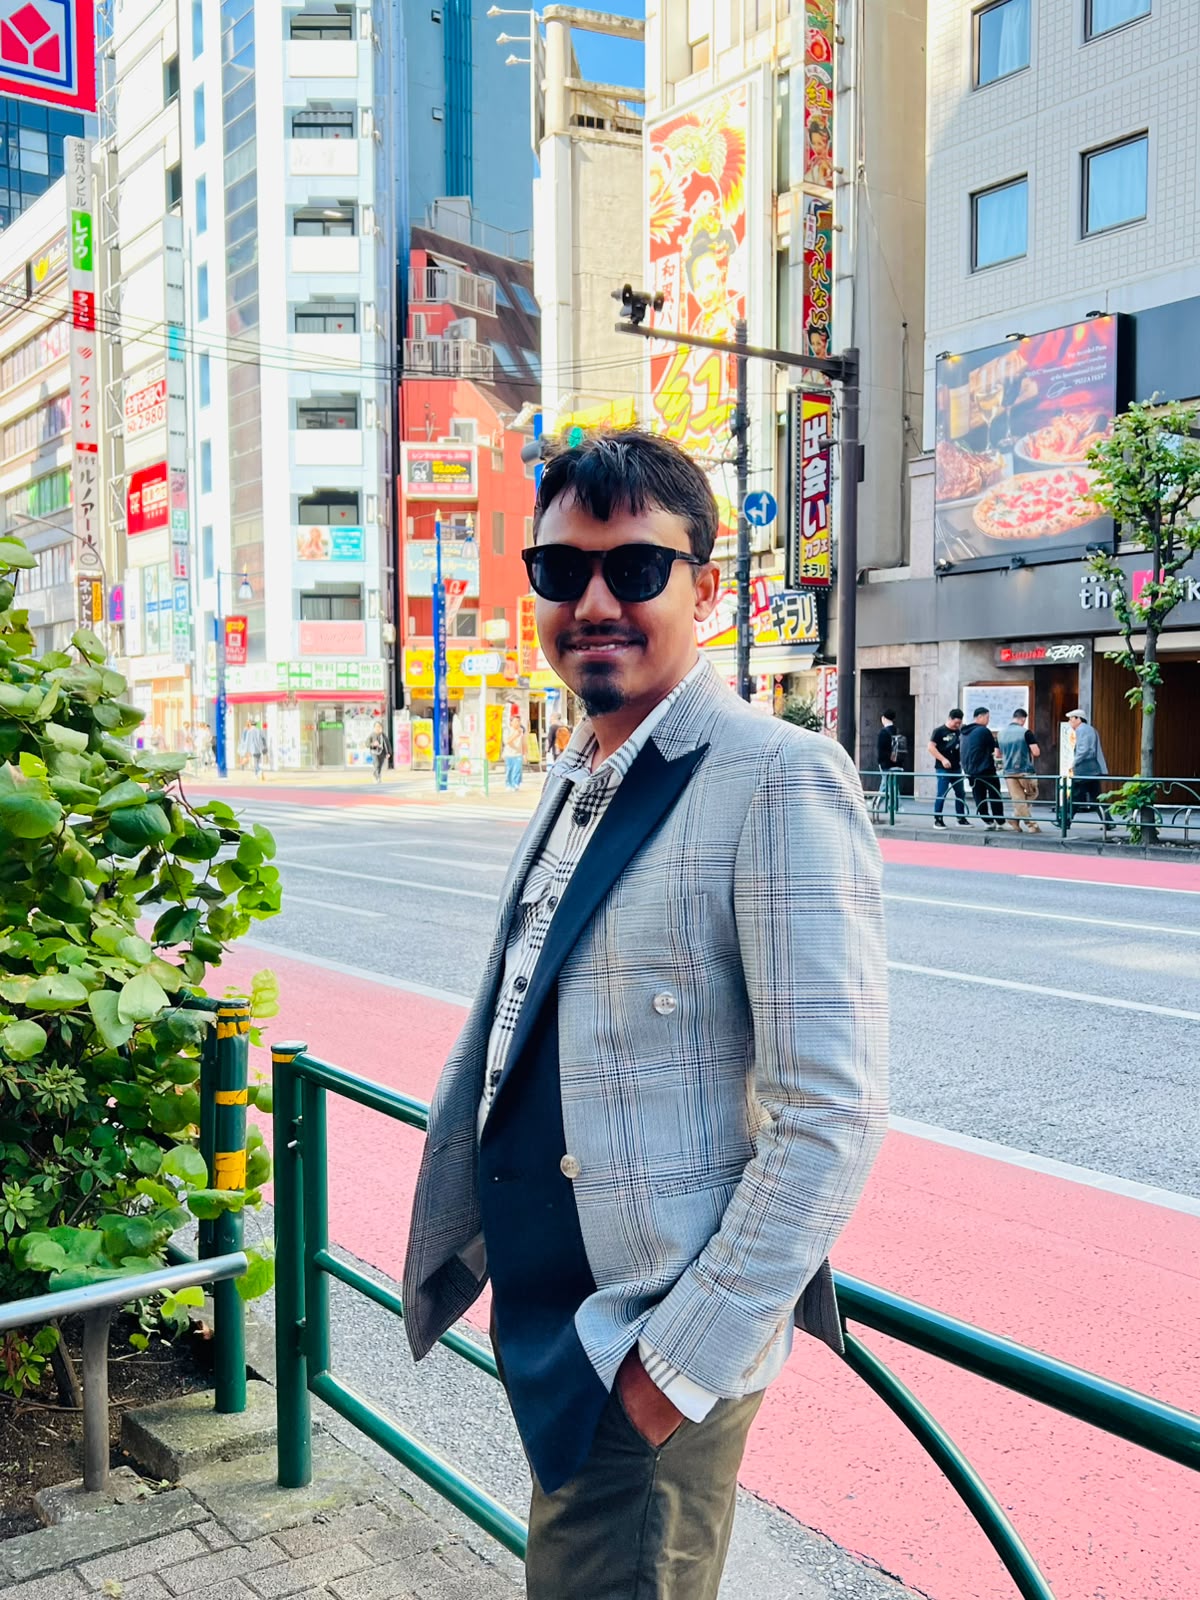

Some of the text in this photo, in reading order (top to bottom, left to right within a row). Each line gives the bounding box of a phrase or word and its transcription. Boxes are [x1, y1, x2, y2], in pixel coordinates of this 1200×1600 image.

[806, 79, 831, 109] 紅
[74, 141, 87, 207] 池袋ハタビル
[75, 219, 89, 259] レイク
[811, 235, 828, 325] くれない
[803, 414, 827, 538] 出会い
[80, 468, 96, 549] ルノアール
[804, 537, 829, 561] カフェ
[802, 563, 826, 577] キラリ
[771, 596, 814, 638] キラリ
[1052, 645, 1085, 661] BAR
